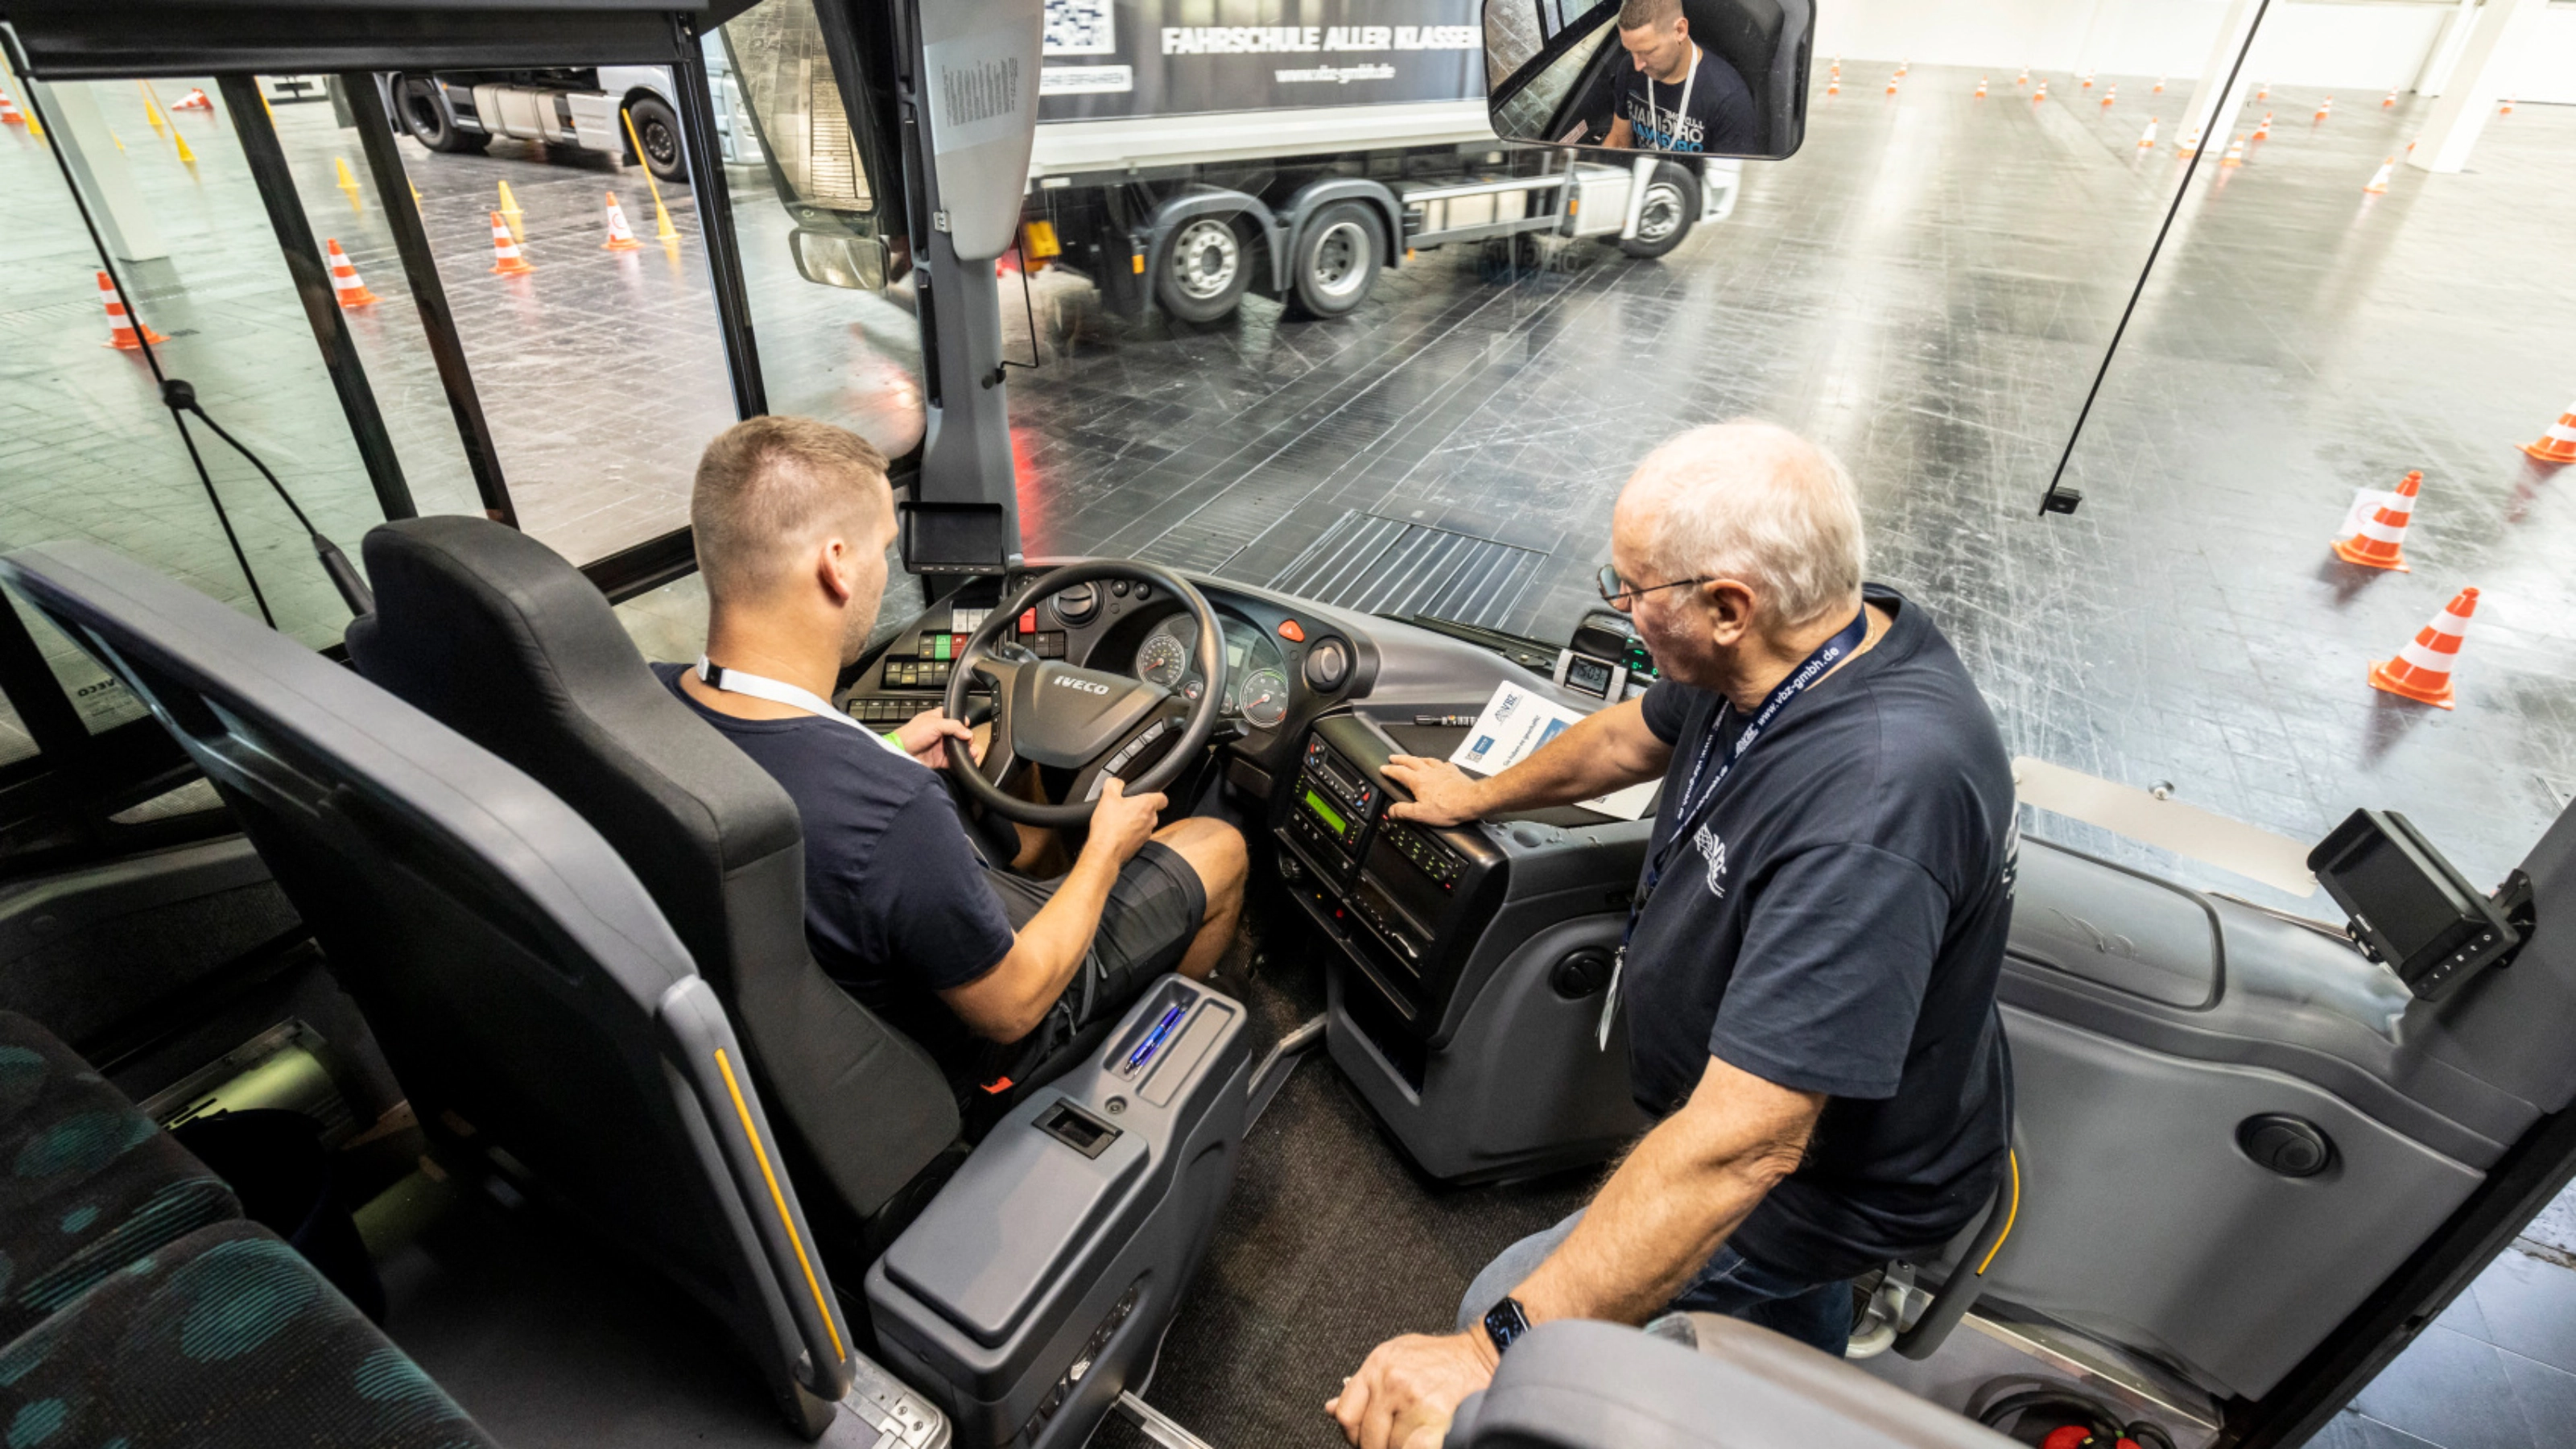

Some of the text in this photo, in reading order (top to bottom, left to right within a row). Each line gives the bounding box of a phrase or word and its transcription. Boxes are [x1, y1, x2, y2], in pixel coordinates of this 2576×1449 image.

[1161, 27, 1321, 54] FAHRSCHULE
[1323, 26, 1392, 51] ALLER
[1053, 675, 1110, 696] IVECO
[1757, 646, 1840, 726] www.vbz-gmbh.de
